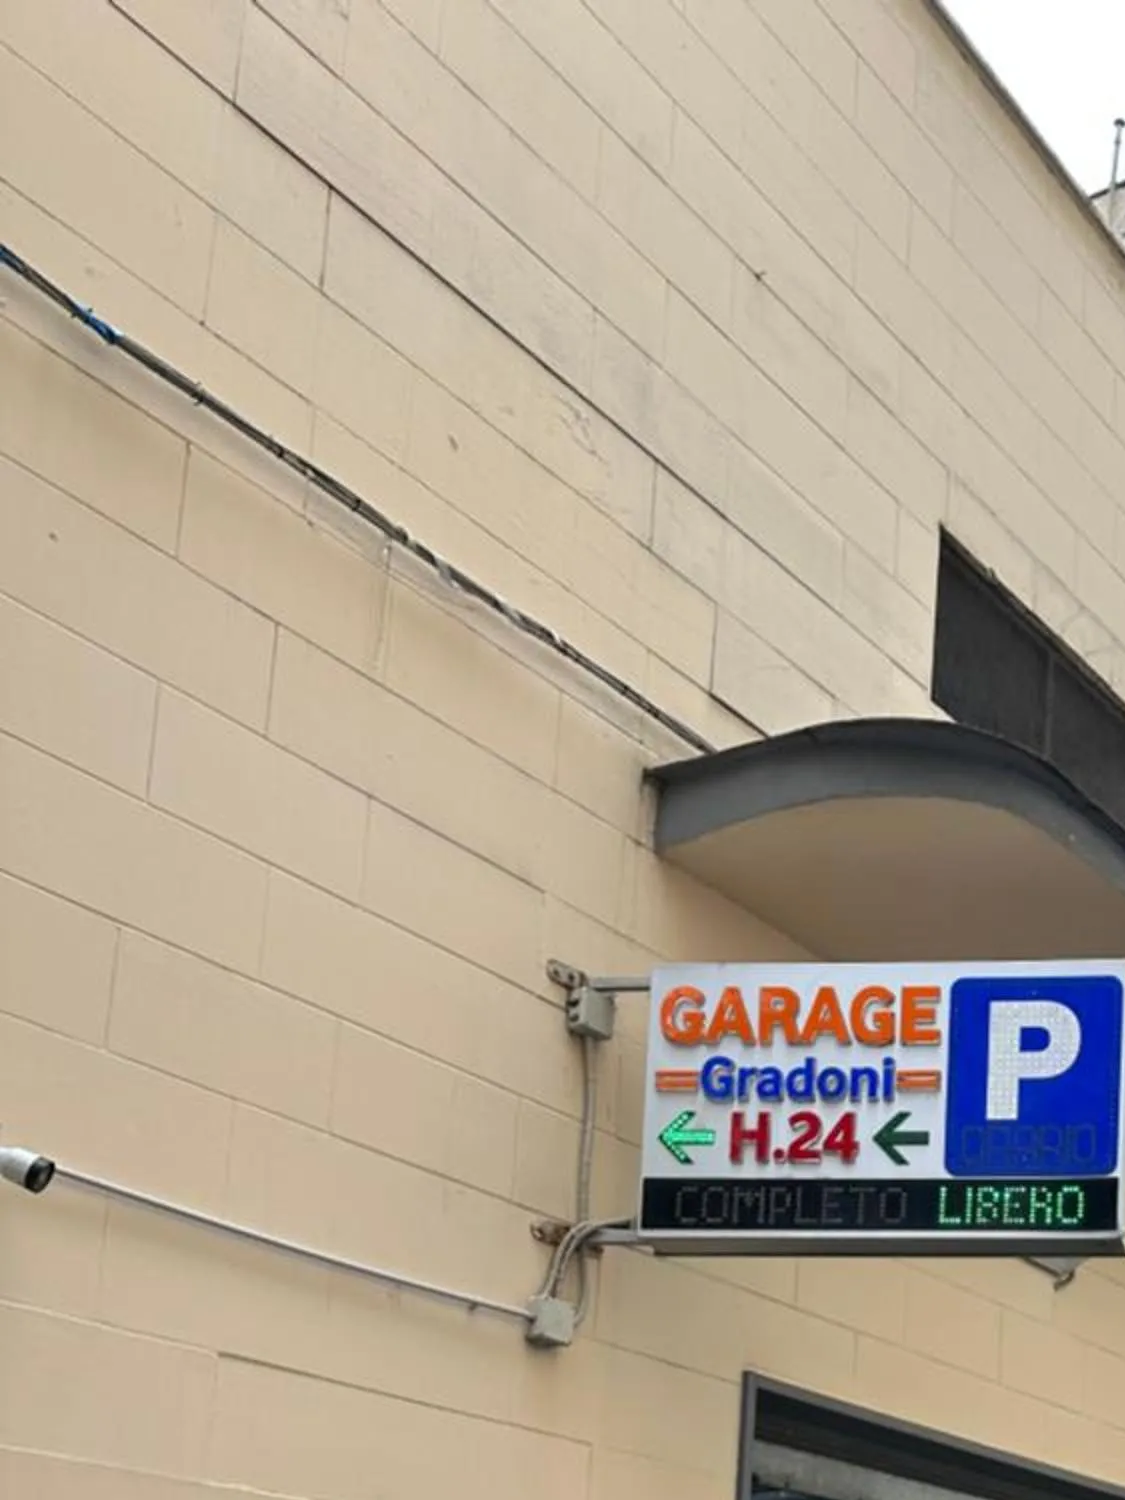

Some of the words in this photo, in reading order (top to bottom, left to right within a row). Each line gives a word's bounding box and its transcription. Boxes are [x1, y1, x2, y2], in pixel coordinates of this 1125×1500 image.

[658, 985, 941, 1047] GARAGE
[700, 1055, 896, 1103] Gradoni
[985, 999, 1081, 1121] P
[729, 1111, 859, 1165] H.24
[673, 1185, 908, 1225] COMPLETO
[937, 1185, 1087, 1225] LIBERO
